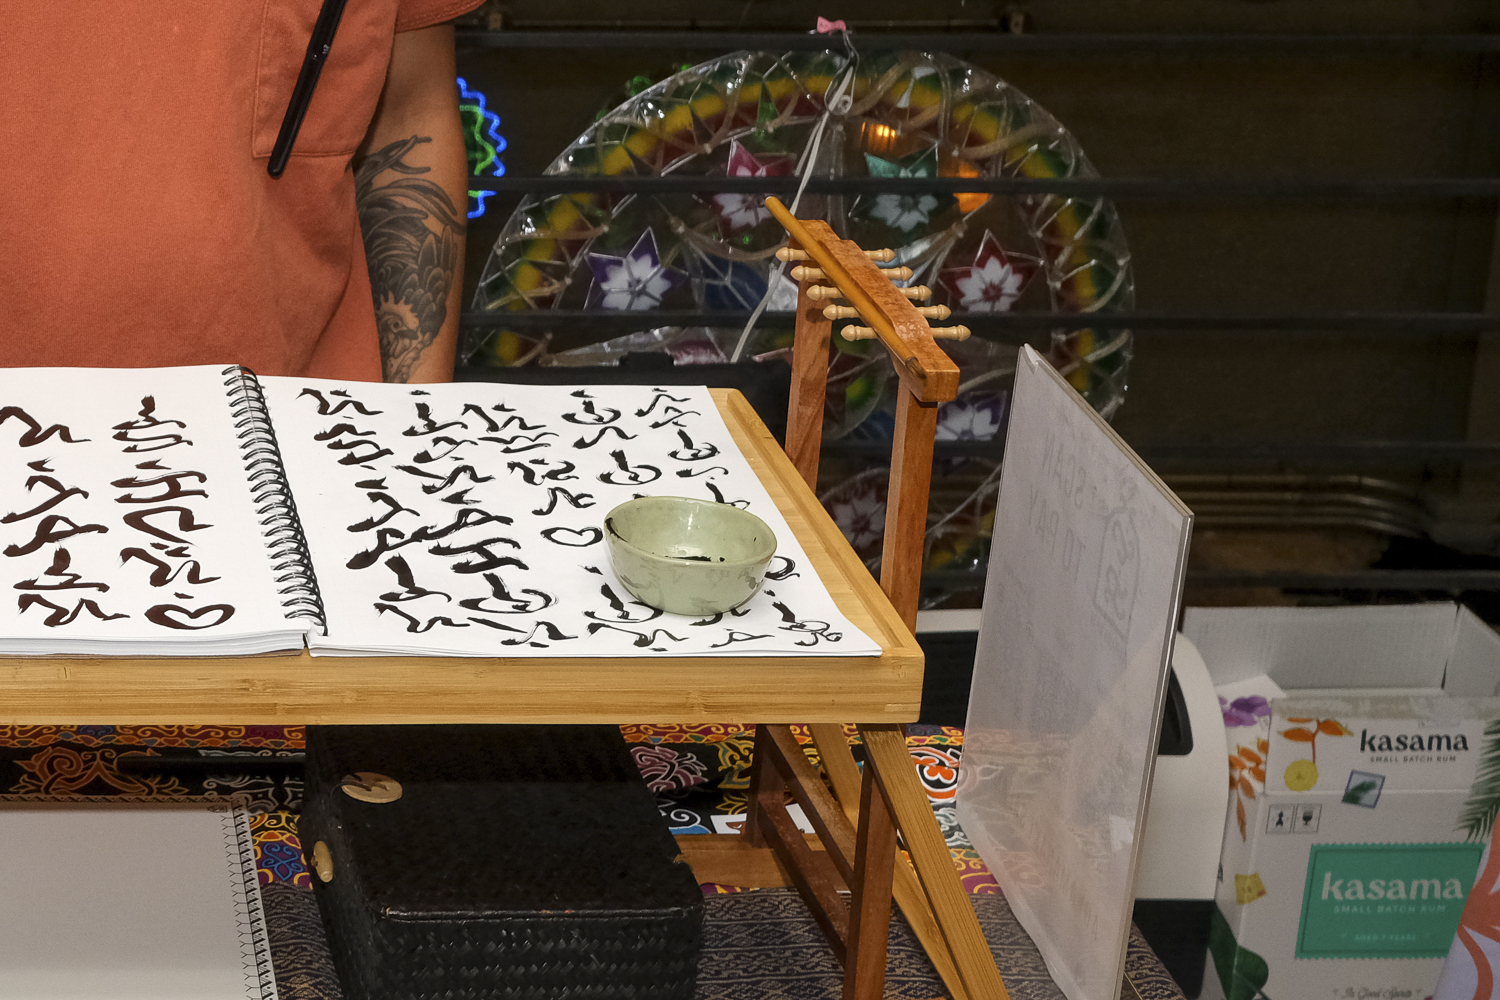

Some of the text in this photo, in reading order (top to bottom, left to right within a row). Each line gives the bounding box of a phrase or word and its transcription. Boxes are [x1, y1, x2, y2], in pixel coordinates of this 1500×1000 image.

[1360, 729, 1469, 753] kasama
[1369, 755, 1457, 763] SMALL BATCH RUM
[1321, 872, 1464, 900] kasama
[1334, 905, 1371, 914] SMALL
